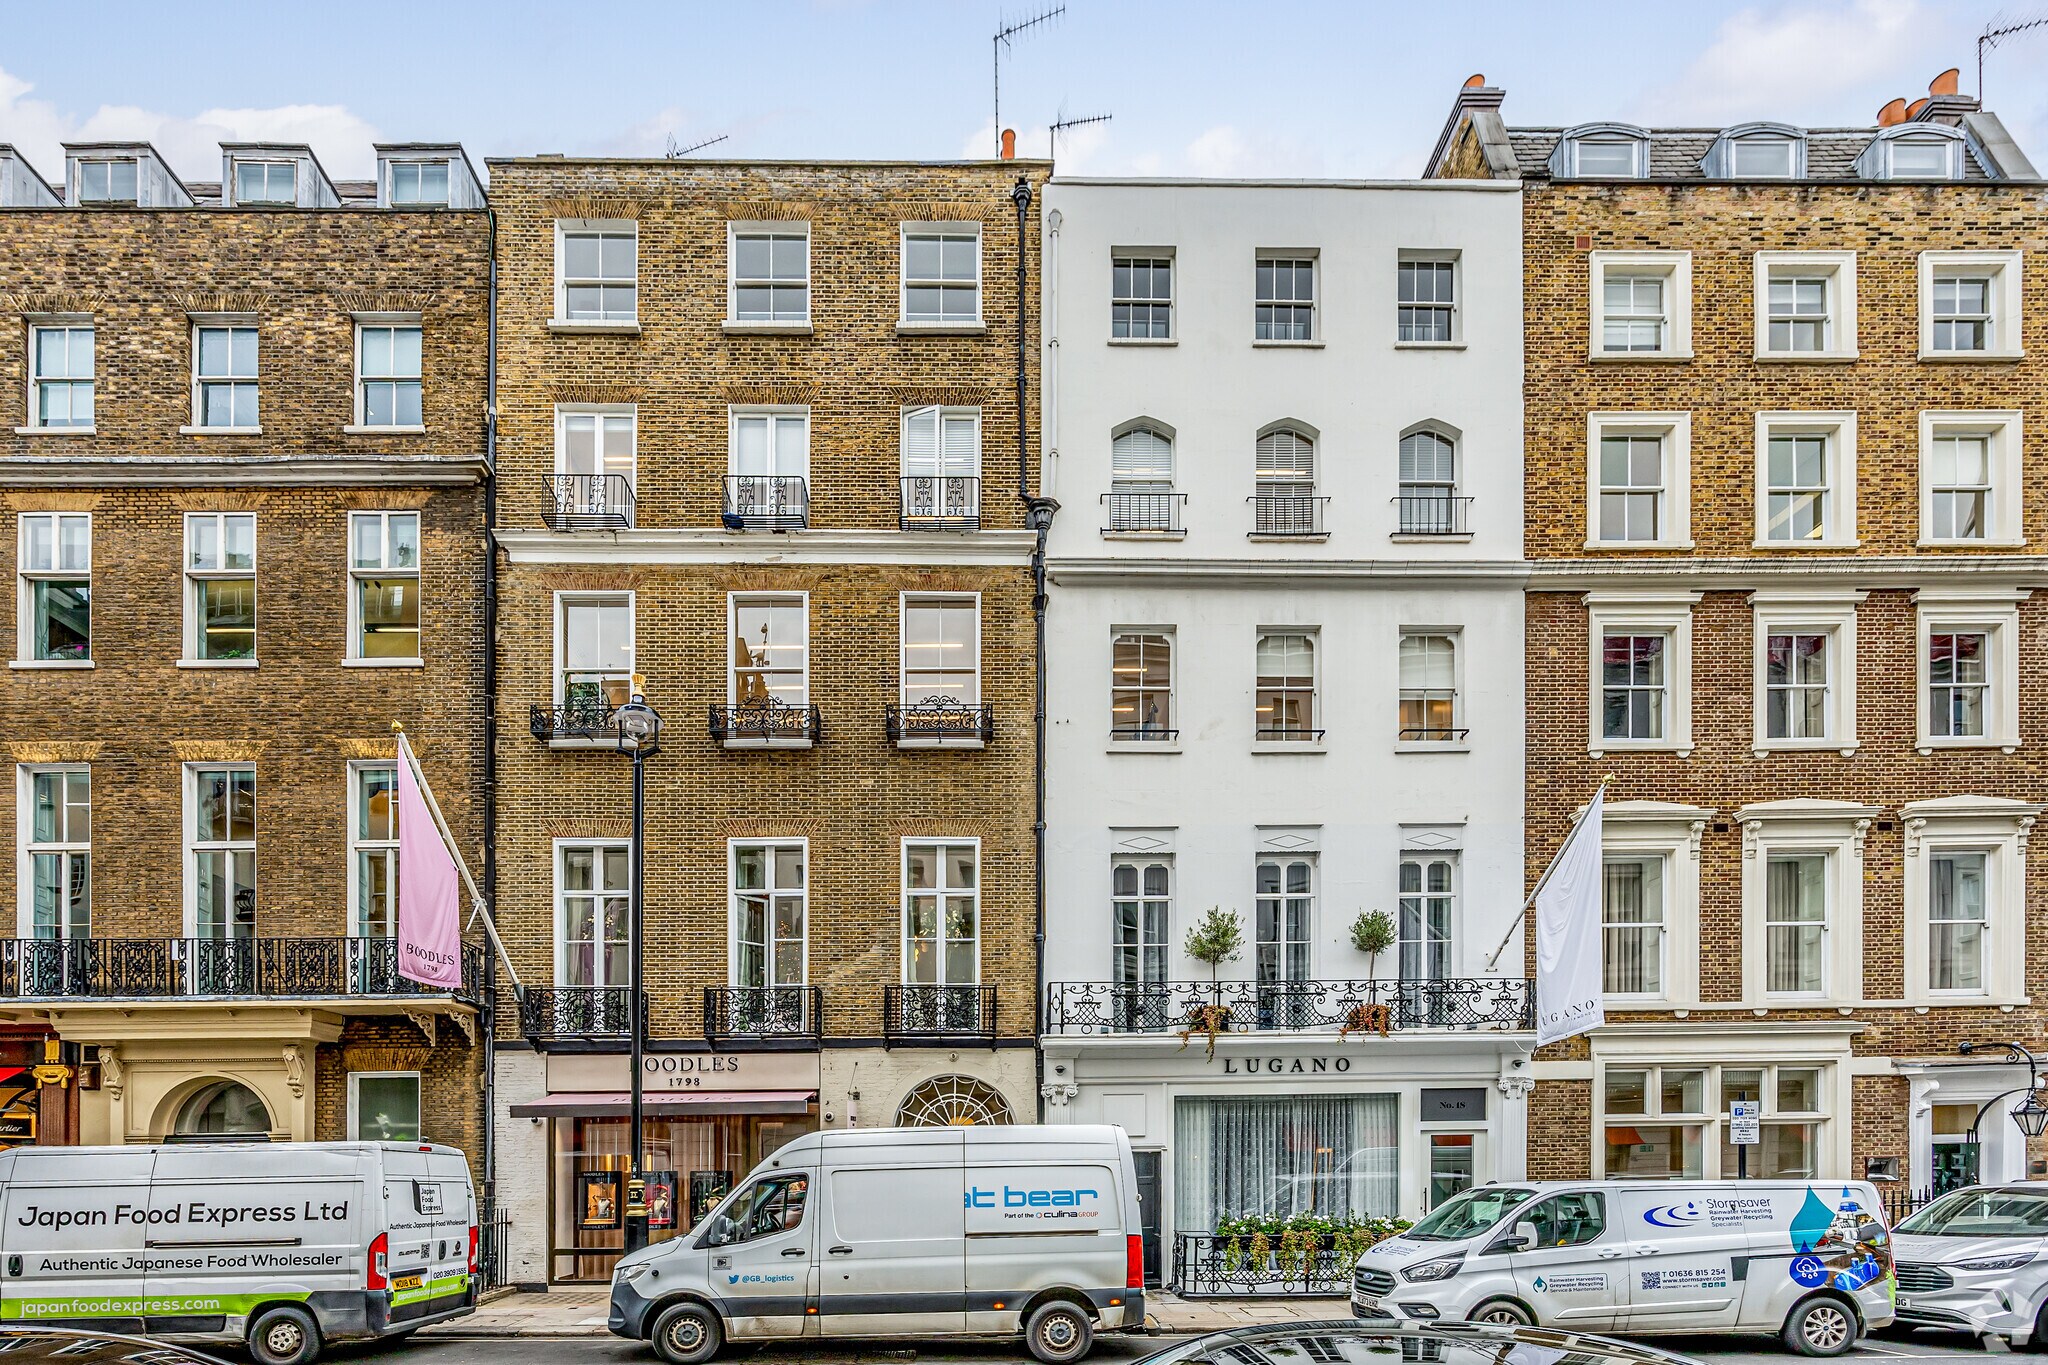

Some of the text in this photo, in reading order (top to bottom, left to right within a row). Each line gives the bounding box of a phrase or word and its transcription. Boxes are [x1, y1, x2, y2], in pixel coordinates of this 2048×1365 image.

[406, 943, 454, 965] BOODLES
[424, 964, 438, 972] 1798
[629, 1057, 738, 1072] OODLES
[1224, 1058, 1350, 1074] LUGANO
[669, 1078, 700, 1086] 1798
[964, 1186, 1098, 1208] t bear
[1706, 1198, 1770, 1209] Stormsaver
[18, 1200, 348, 1231] Japan Food Express Ltd
[40, 1253, 342, 1272] Authentic Japanese Food Wholesaler
[742, 1275, 794, 1283] @GB_logistics
[20, 1299, 220, 1319] japanfoodexpress.com
